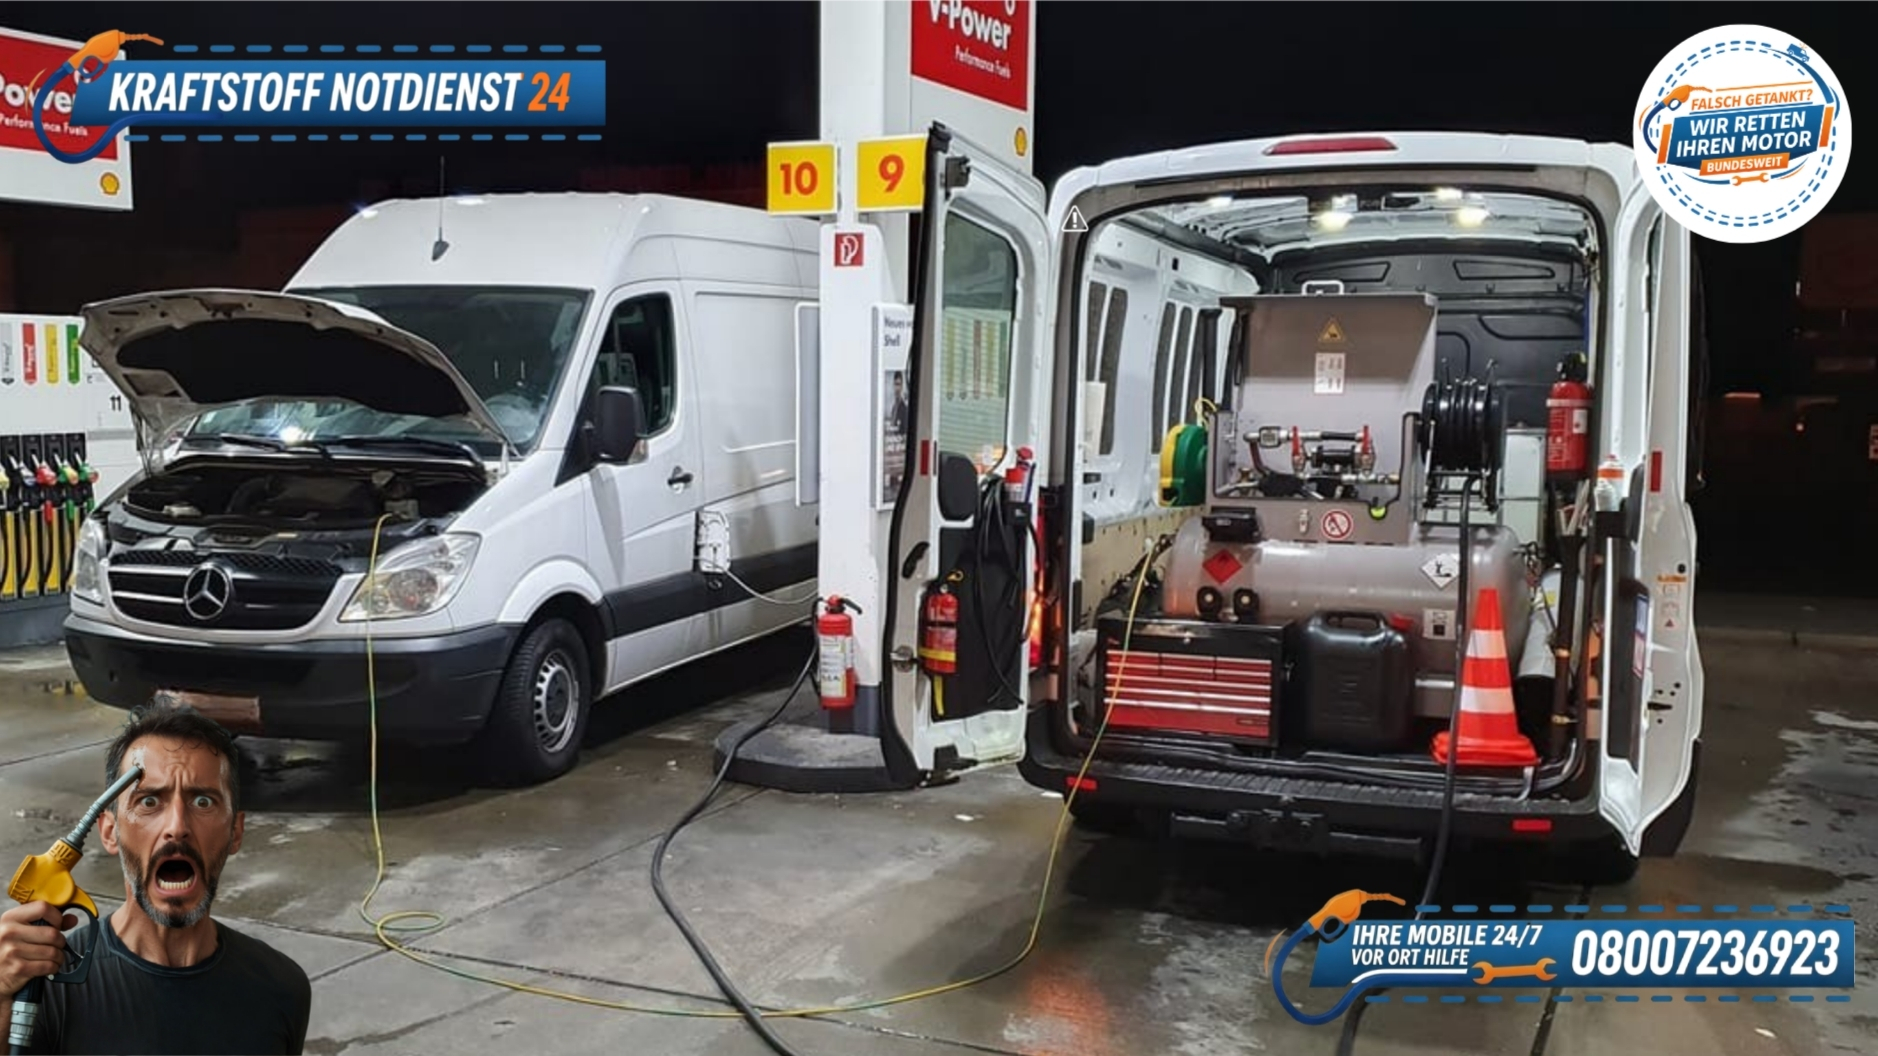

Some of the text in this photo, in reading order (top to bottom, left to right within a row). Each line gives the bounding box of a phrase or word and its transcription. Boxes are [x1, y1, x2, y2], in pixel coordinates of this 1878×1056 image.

[779, 162, 818, 196] 10
[878, 154, 904, 192] 9
[110, 395, 122, 411] 11
